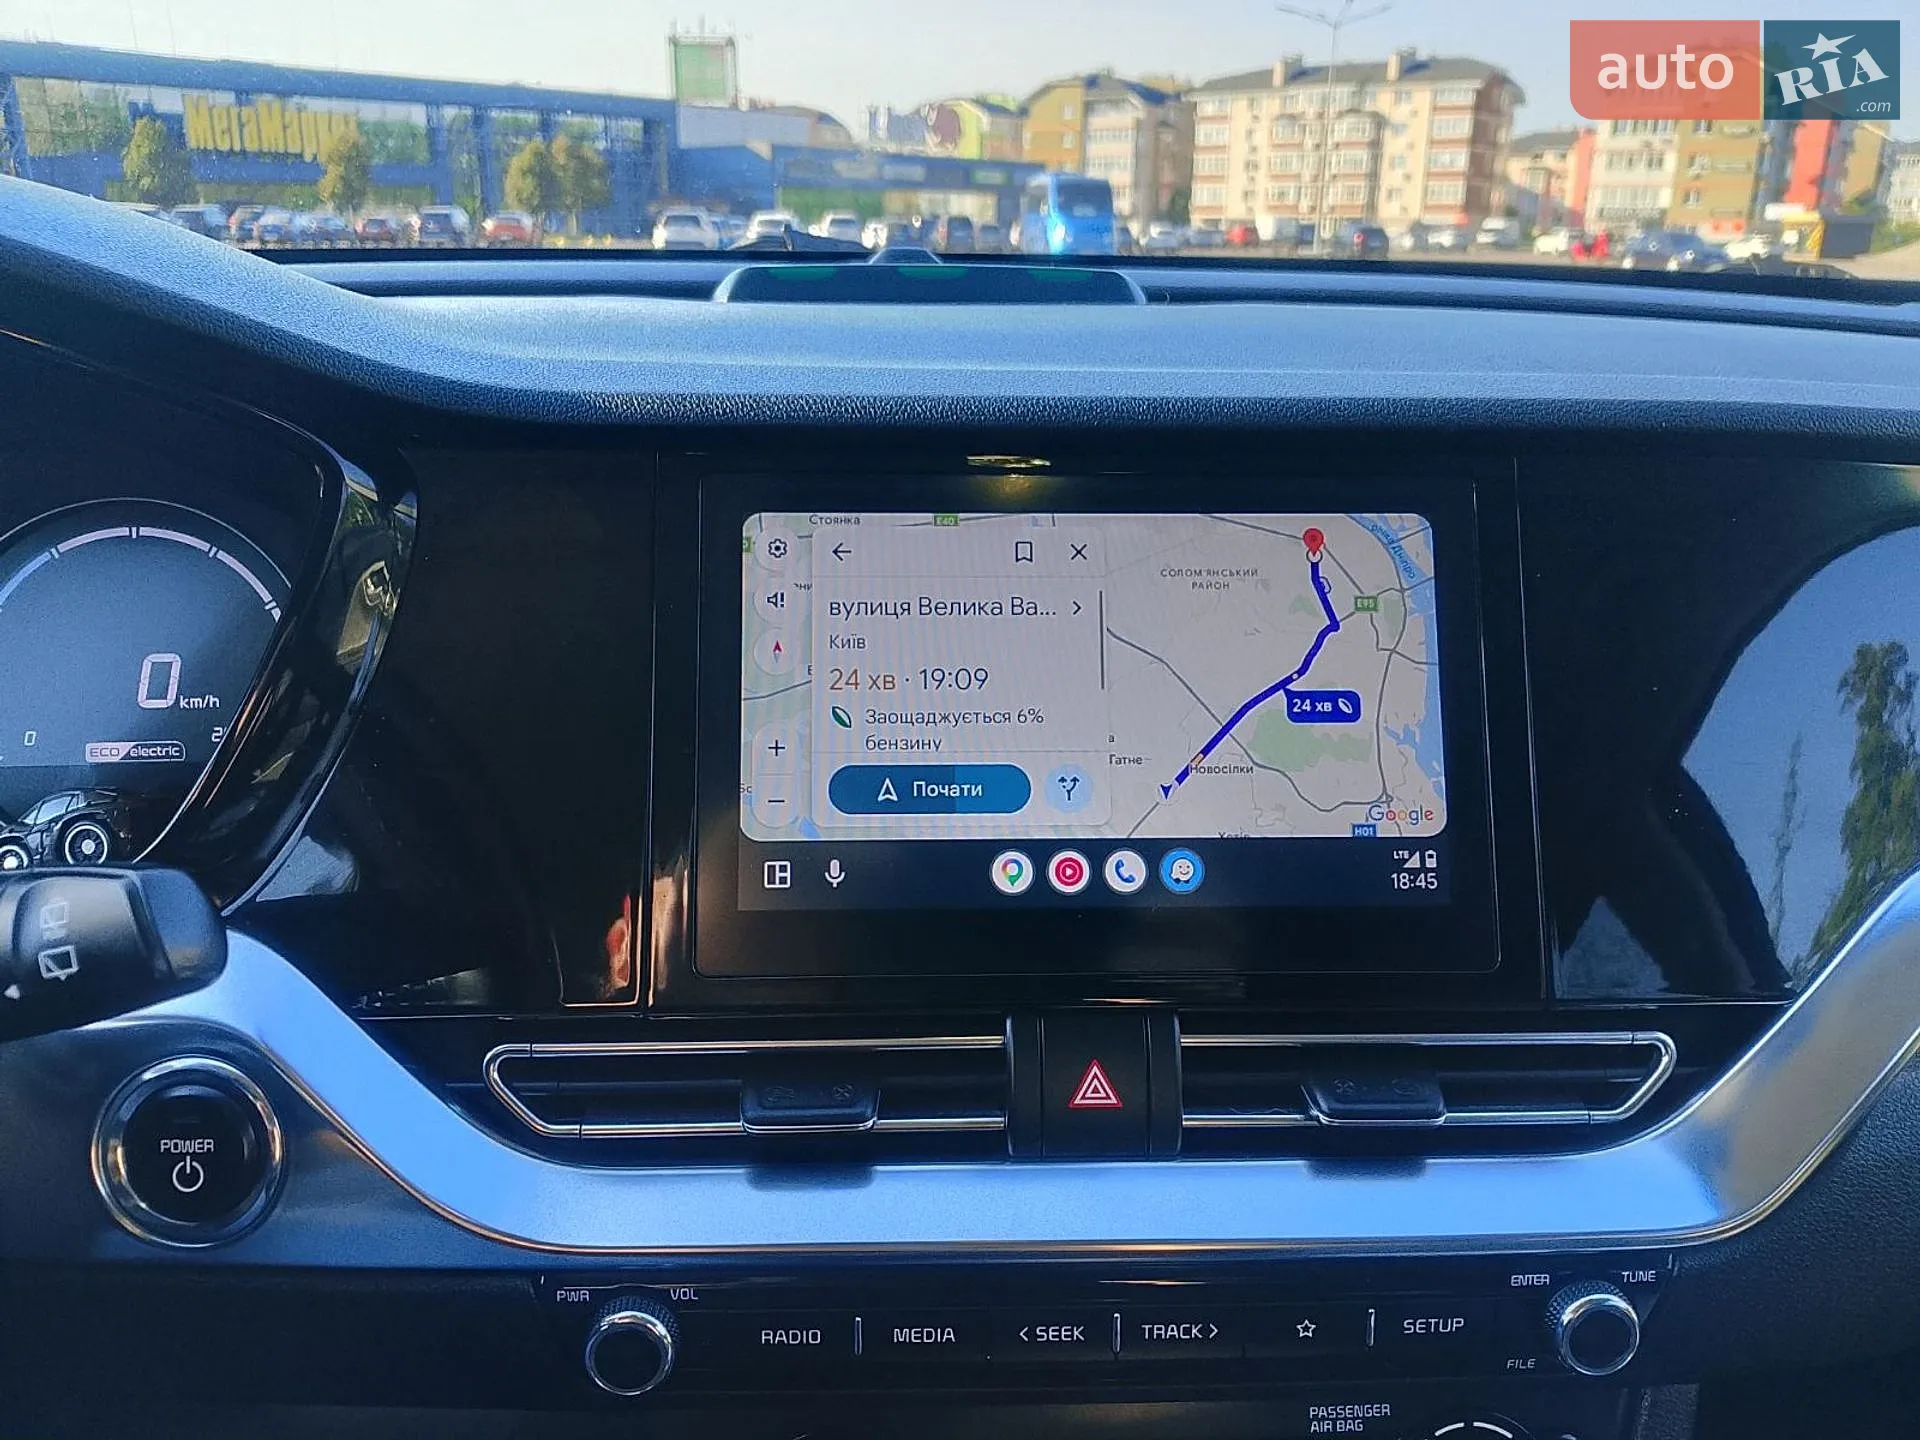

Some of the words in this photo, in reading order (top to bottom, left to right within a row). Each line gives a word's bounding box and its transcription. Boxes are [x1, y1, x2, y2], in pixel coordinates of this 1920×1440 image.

[808, 514, 861, 526] Стоянка
[1391, 543, 1416, 580] Дніпро
[1191, 580, 1231, 591] РАЙОН
[828, 601, 912, 621] вулиця
[918, 597, 1004, 617] Велика
[828, 634, 867, 650] Київ
[137, 653, 182, 709] 0
[180, 695, 220, 709] km/h
[829, 668, 860, 691] 24
[867, 673, 896, 691] хв
[918, 668, 989, 691] 19:09
[1292, 698, 1312, 713] 24
[1315, 701, 1333, 712] хв
[865, 709, 1012, 726] Заощаджується
[1016, 708, 1045, 724] 6%
[24, 730, 37, 746] 0
[865, 736, 942, 752] бензину
[89, 747, 120, 758] ECO
[129, 744, 181, 758] electric
[1108, 754, 1143, 766] Гатне
[1189, 763, 1255, 775] Новосілки
[912, 781, 983, 798] Почати
[1368, 804, 1434, 826] Google
[1393, 850, 1410, 860] LTE
[1390, 872, 1439, 890] 18:45
[160, 1139, 215, 1154] POWER
[1510, 1273, 1551, 1287] ENTER
[1621, 1270, 1657, 1283] TUNE
[556, 1289, 590, 1303] PWR
[670, 1287, 699, 1300] VOL
[1035, 1325, 1086, 1342] SEEK
[1142, 1322, 1204, 1339] TRACK
[1403, 1317, 1465, 1334] SETUP
[761, 1329, 821, 1345] RADIO
[893, 1327, 956, 1344] MEDIA
[1506, 1358, 1537, 1370] FILE
[1309, 1403, 1391, 1419] PASSENGER
[1310, 1420, 1333, 1433] AIR
[1336, 1419, 1364, 1432] BAG
